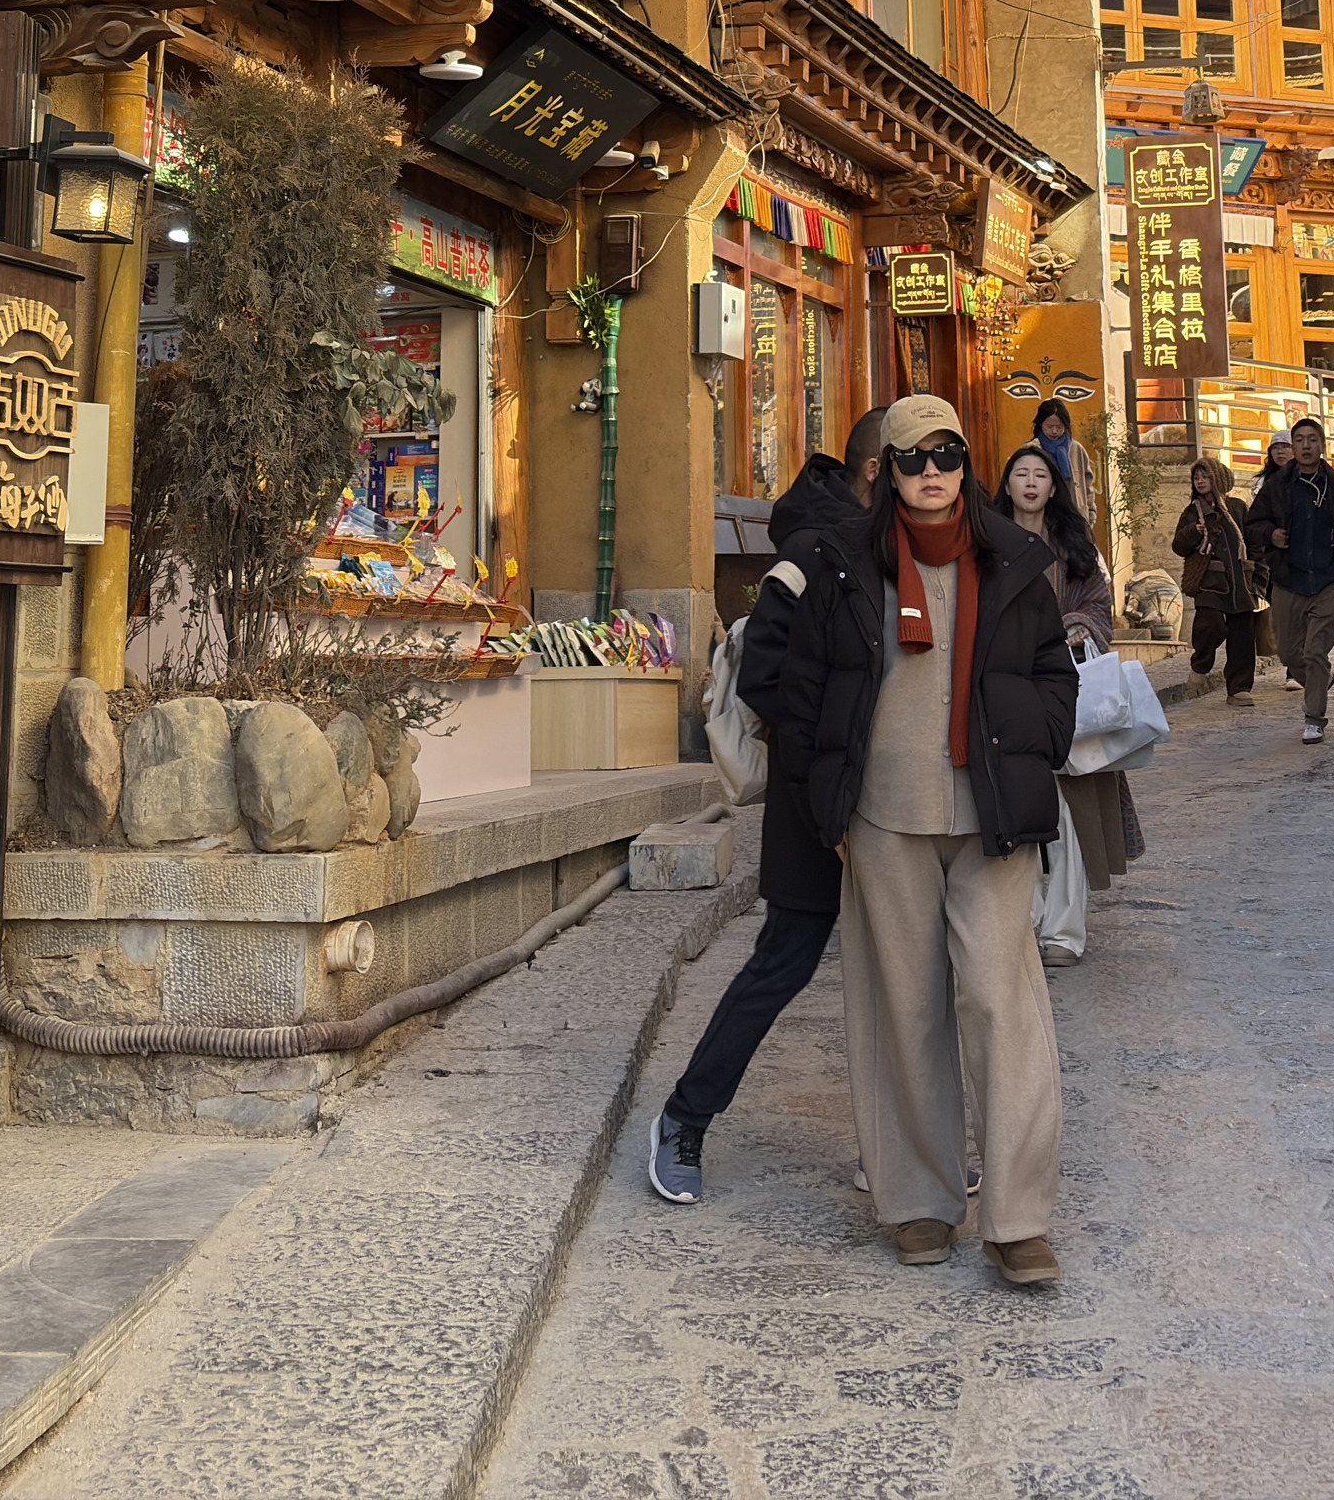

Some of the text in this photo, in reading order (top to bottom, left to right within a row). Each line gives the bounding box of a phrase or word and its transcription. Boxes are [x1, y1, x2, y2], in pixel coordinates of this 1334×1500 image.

[489, 80, 609, 161] 月光宝藏
[1156, 149, 1186, 167] 藏金
[1135, 166, 1209, 187] 文创工作室
[895, 274, 946, 289] 文创工作室
[1138, 215, 1153, 367] Shangri-La Gift Collection Stor
[1148, 213, 1178, 369] 伴手礼集合店
[1178, 238, 1207, 343] 香格里拉
